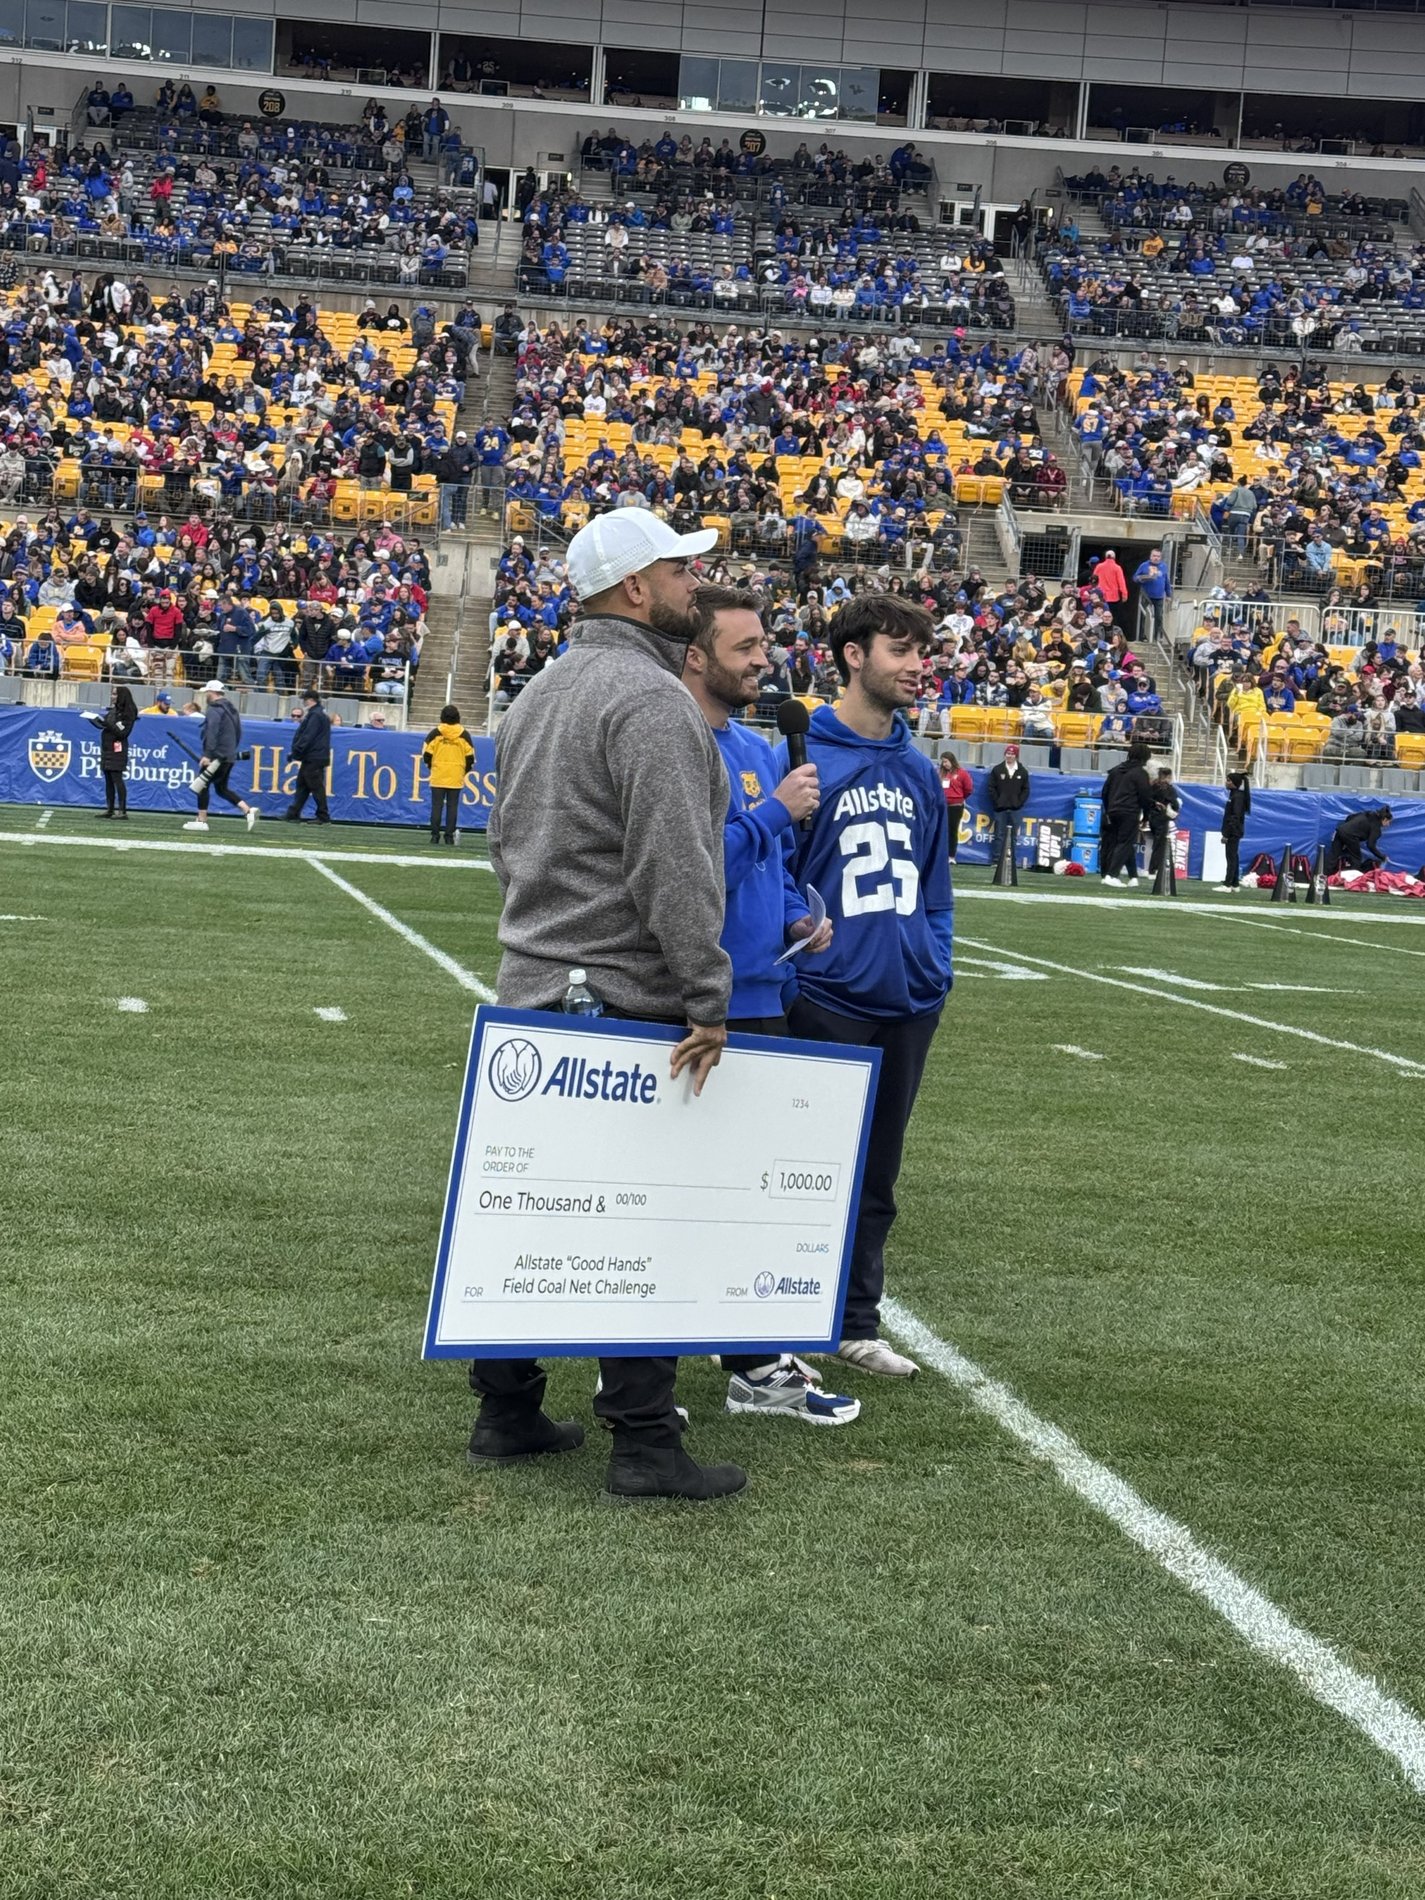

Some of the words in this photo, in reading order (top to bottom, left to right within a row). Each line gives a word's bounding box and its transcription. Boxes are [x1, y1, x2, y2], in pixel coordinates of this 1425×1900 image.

[80, 741, 151, 761] Unsity
[152, 744, 168, 759] of
[79, 756, 195, 789] Pisburgh
[348, 750, 397, 800] To
[833, 783, 914, 820] Allstate
[1039, 824, 1051, 867] STAND
[1050, 834, 1062, 858] UP!
[1175, 838, 1187, 870] MAKE
[839, 819, 919, 918] 25
[541, 1056, 657, 1104] Allstate
[791, 1098, 809, 1109] 1234
[485, 1145, 503, 1157] PAY
[504, 1146, 516, 1158] TO
[518, 1147, 535, 1159] THE
[483, 1160, 515, 1172] ORDER
[516, 1162, 529, 1173] OF
[760, 1170, 769, 1192] $
[780, 1171, 832, 1192] 1,000.00
[479, 1190, 512, 1210] One
[517, 1191, 593, 1213] Thousand
[595, 1195, 606, 1213] &
[615, 1191, 647, 1206] 00/100
[796, 1243, 829, 1254] DOLLARS
[514, 1254, 563, 1271] Allstate
[567, 1255, 605, 1271] “Good
[607, 1256, 652, 1272] Hands”
[464, 1286, 484, 1297] FOR
[502, 1277, 535, 1294] Field
[537, 1278, 566, 1294] Goal
[569, 1278, 592, 1294] Net
[595, 1278, 656, 1298] Challenge
[726, 1287, 748, 1297] FROM
[774, 1276, 821, 1295] Allstate
